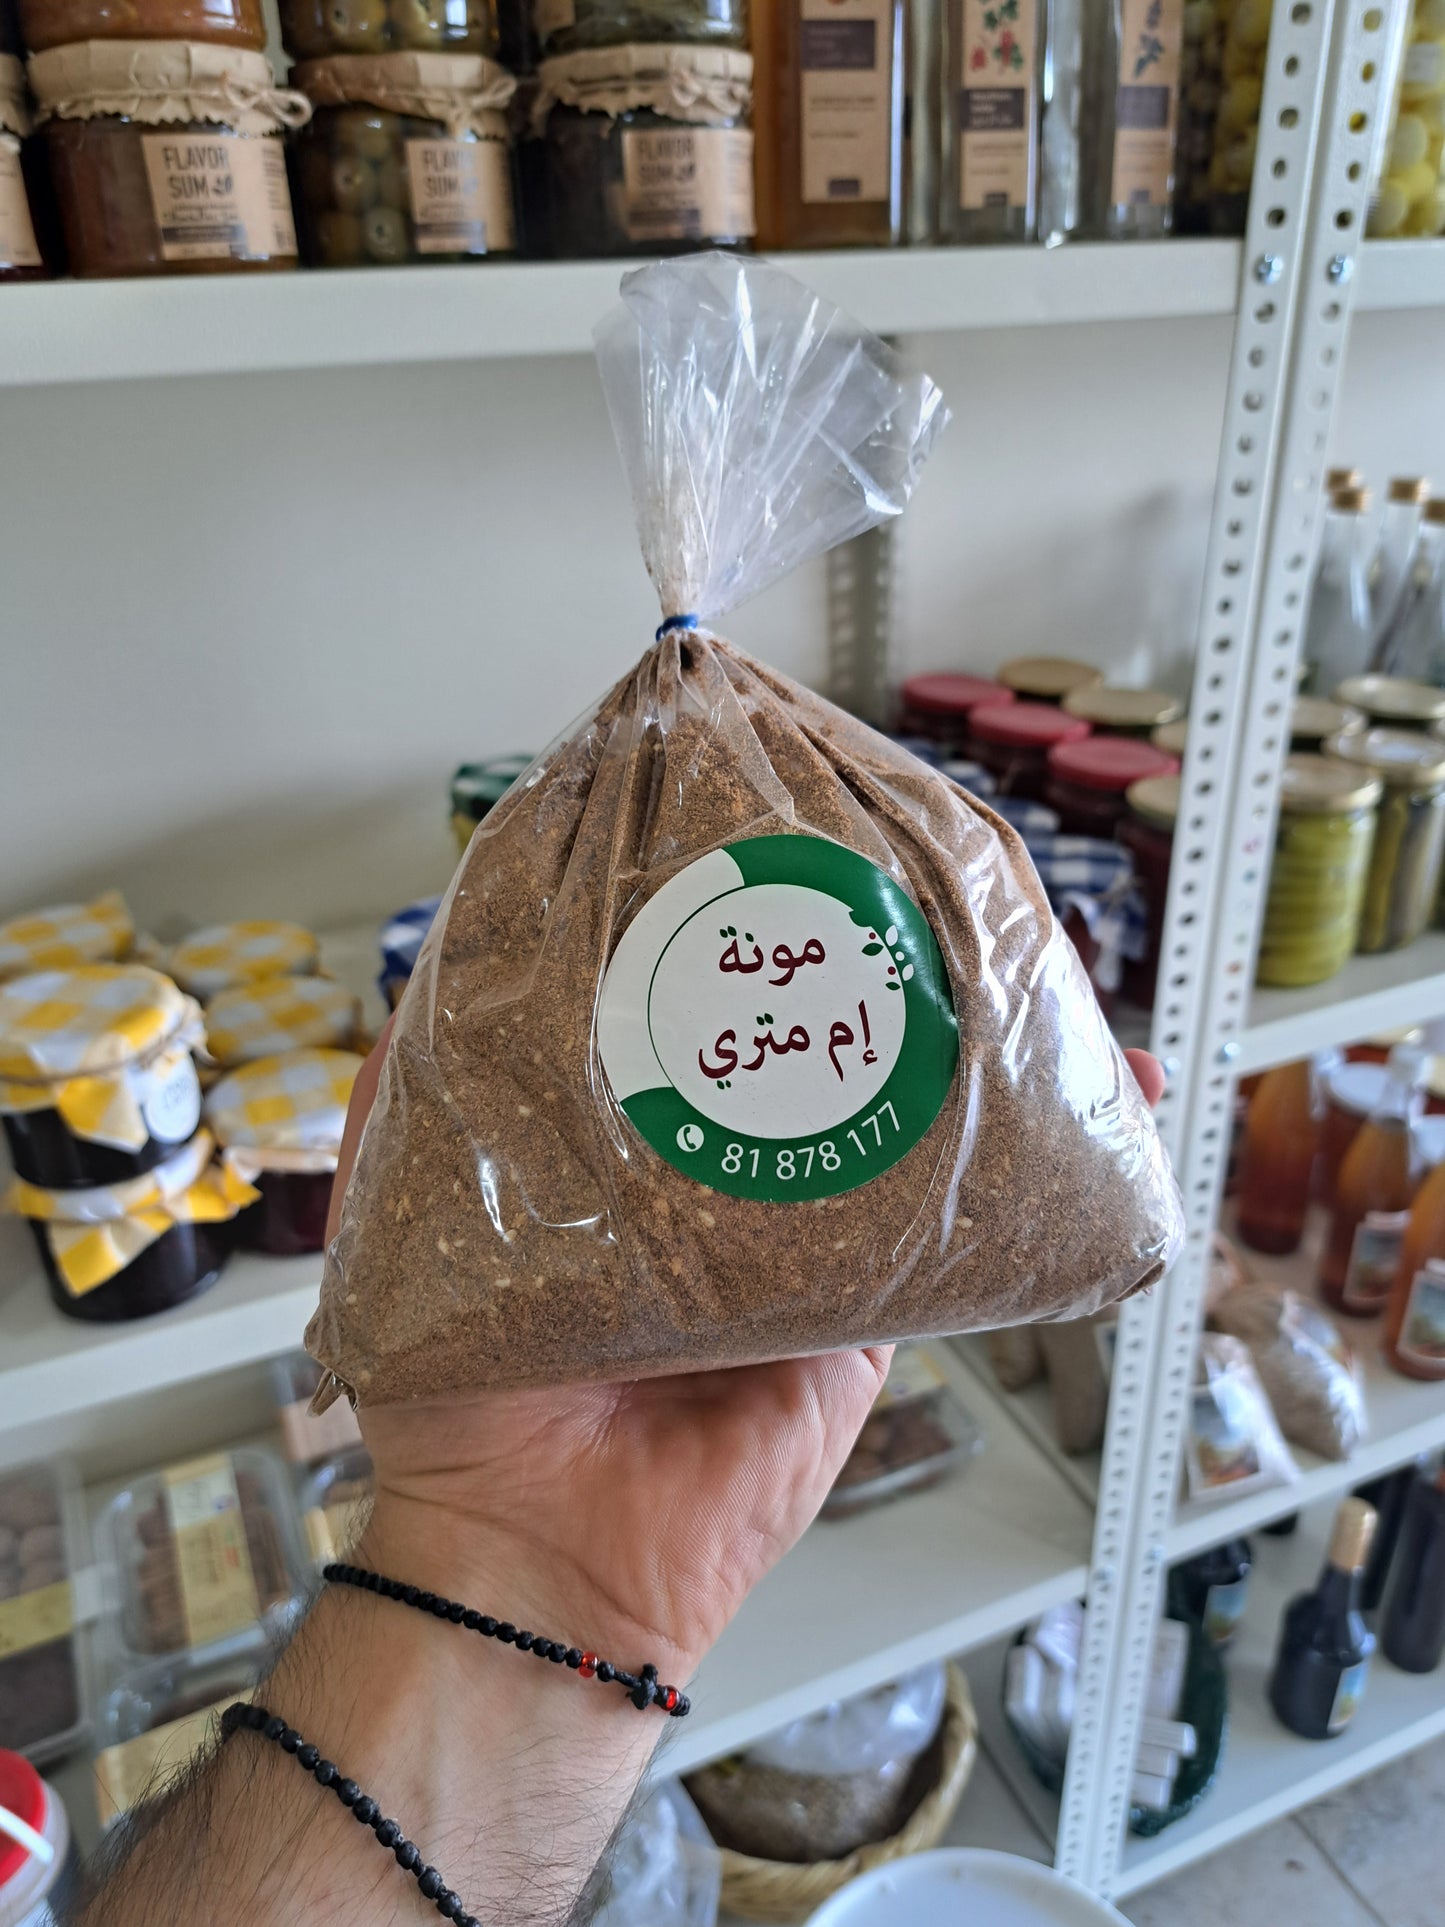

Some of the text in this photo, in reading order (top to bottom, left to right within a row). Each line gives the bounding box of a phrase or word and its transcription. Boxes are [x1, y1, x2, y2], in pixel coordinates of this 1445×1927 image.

[163, 145, 230, 171] FLAVOR
[169, 175, 210, 199] SUM
[719, 925, 826, 987] مونة
[698, 999, 878, 1090] إم متري
[721, 1100, 900, 1180] 81 878 177
